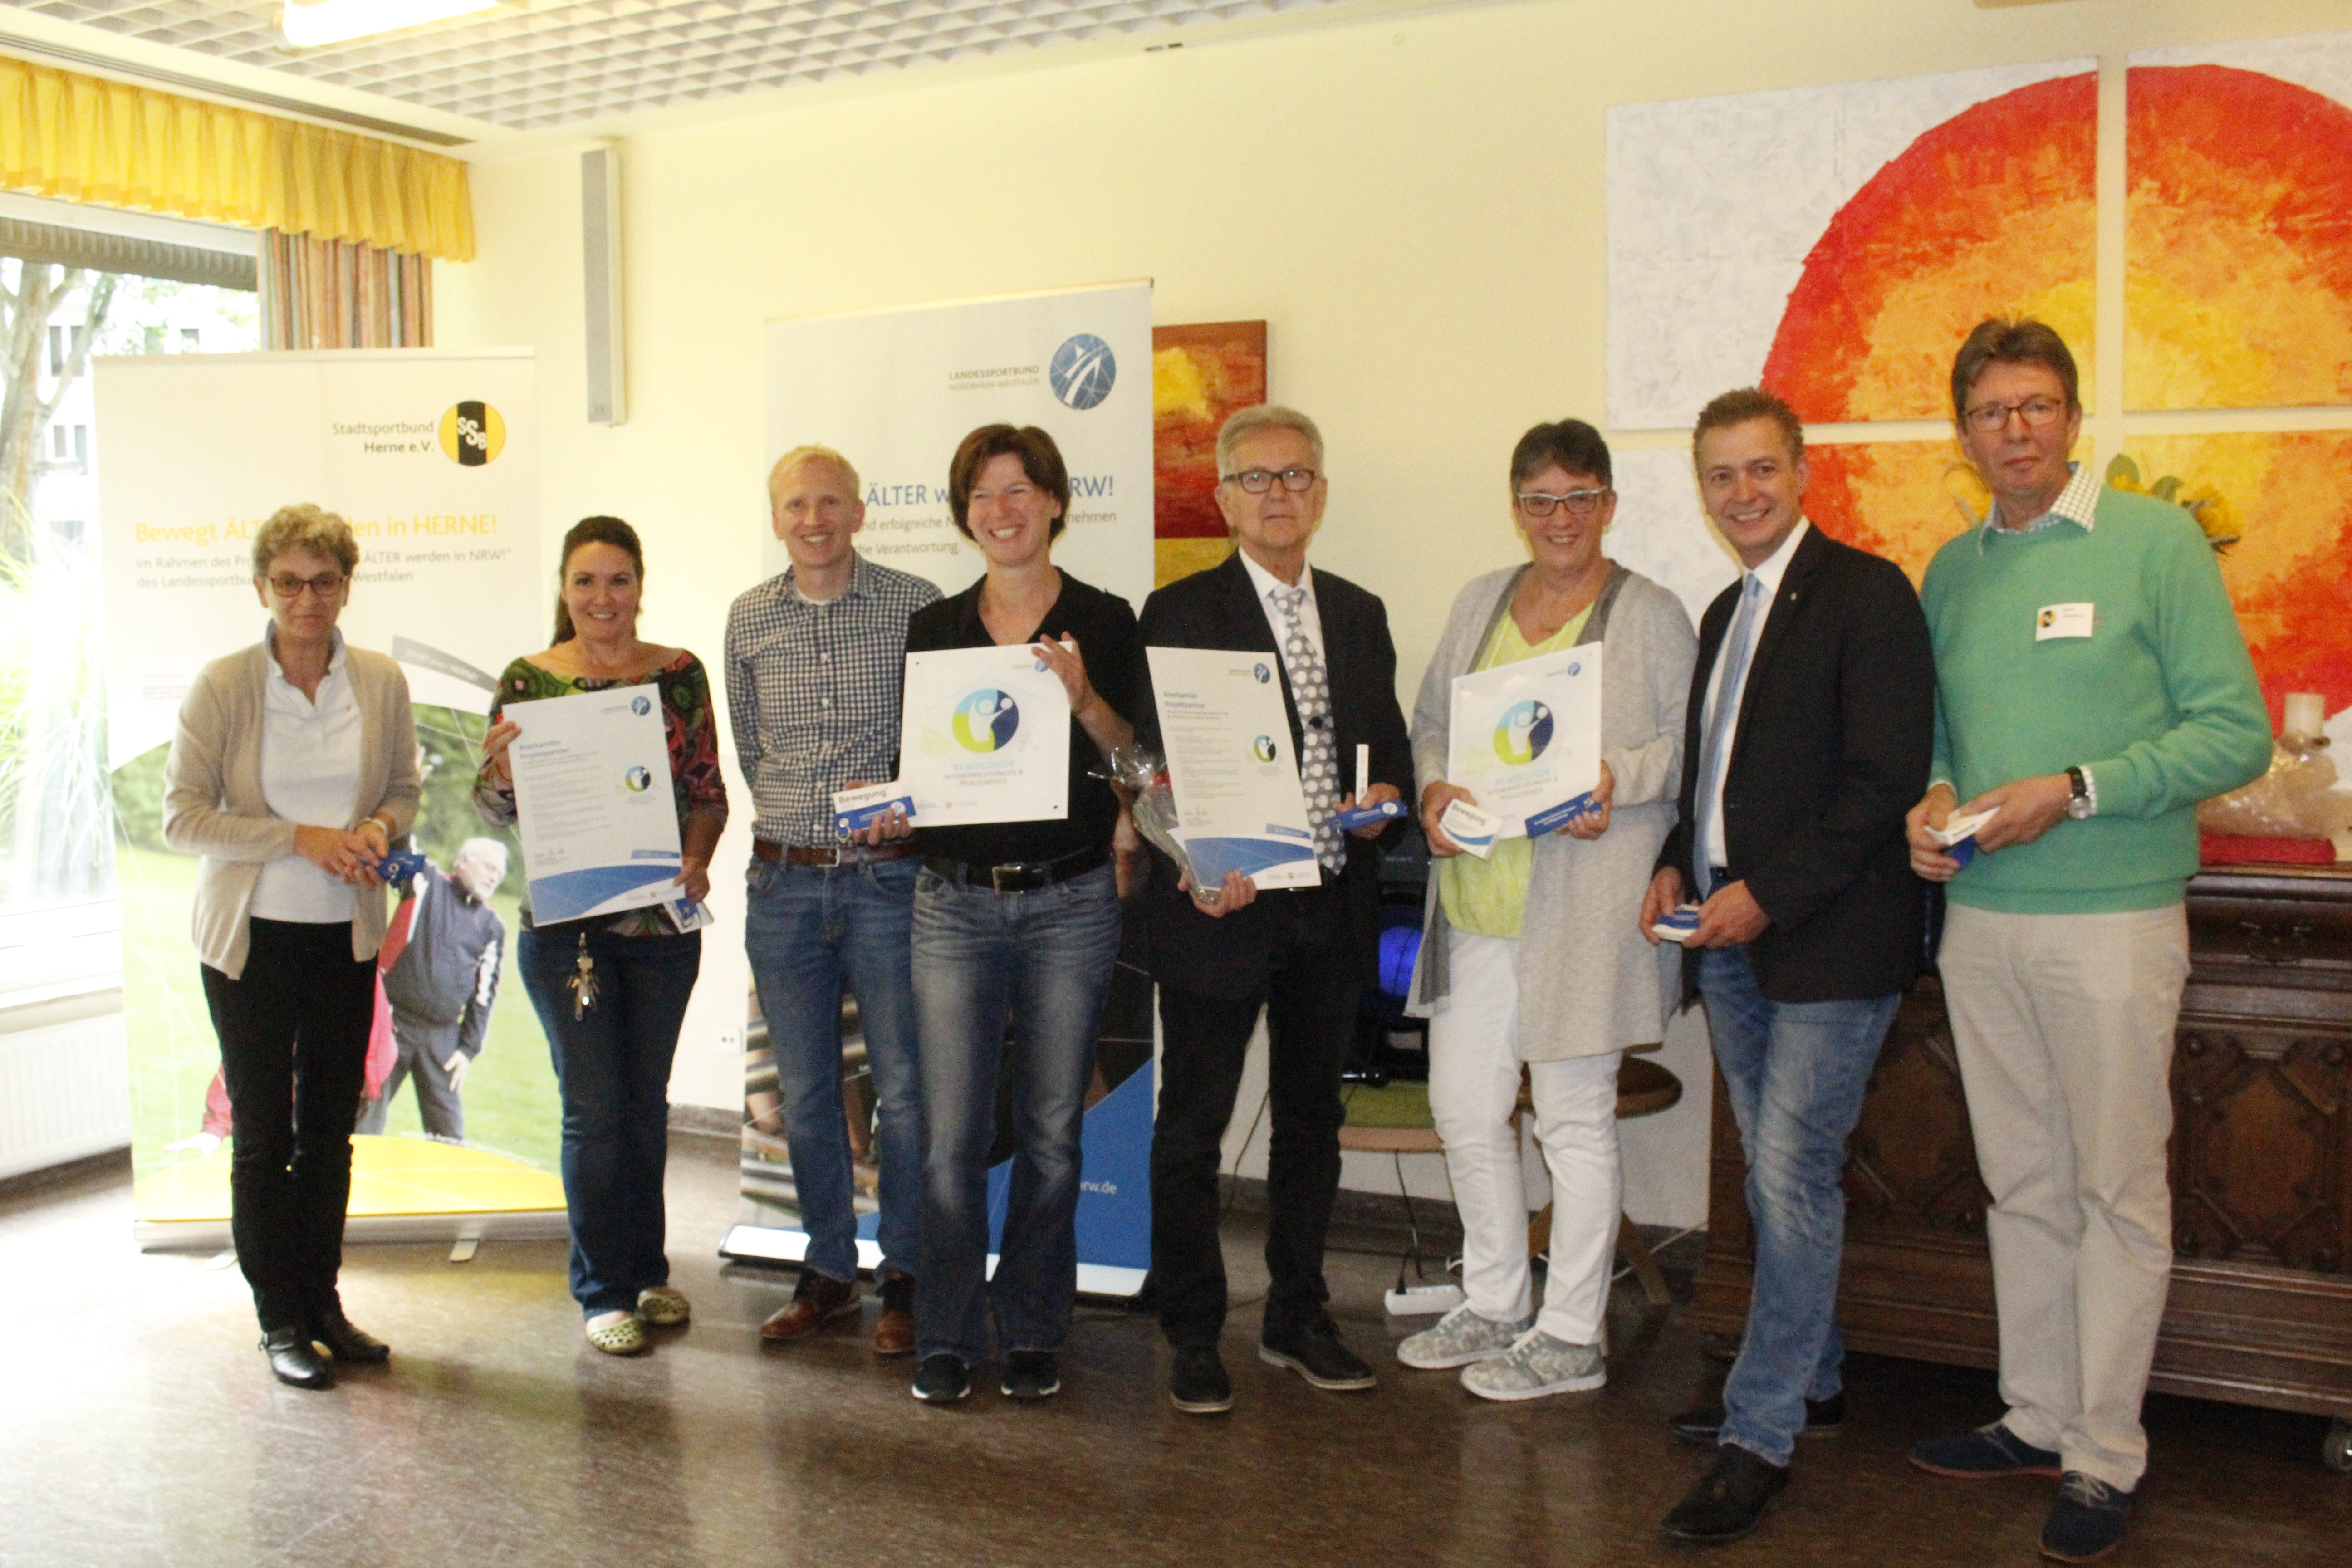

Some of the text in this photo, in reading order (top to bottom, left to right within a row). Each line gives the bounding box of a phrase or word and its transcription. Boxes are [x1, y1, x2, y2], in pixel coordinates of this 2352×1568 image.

[949, 365, 1040, 380] LANDESSPORTBUND
[332, 421, 434, 438] Stadtsportbund
[363, 440, 435, 453] Herne e.V.
[866, 482, 927, 507] ÄLTER
[1068, 476, 1113, 497] RW!
[879, 515, 942, 533] erfolgreiche
[1067, 510, 1117, 523] nehmen
[135, 522, 218, 547] Bewegt
[225, 516, 266, 539] ÄLT
[387, 516, 407, 535] in
[413, 514, 497, 535] HERNE!
[136, 557, 152, 568] Im
[156, 556, 207, 568] Rahmen
[210, 554, 231, 568] des
[364, 550, 400, 564] ÄLTER
[405, 550, 451, 563] werden
[454, 549, 466, 561] in
[137, 575, 157, 588] des
[161, 573, 253, 589] Landessportbu
[838, 790, 886, 804] Bewegung
